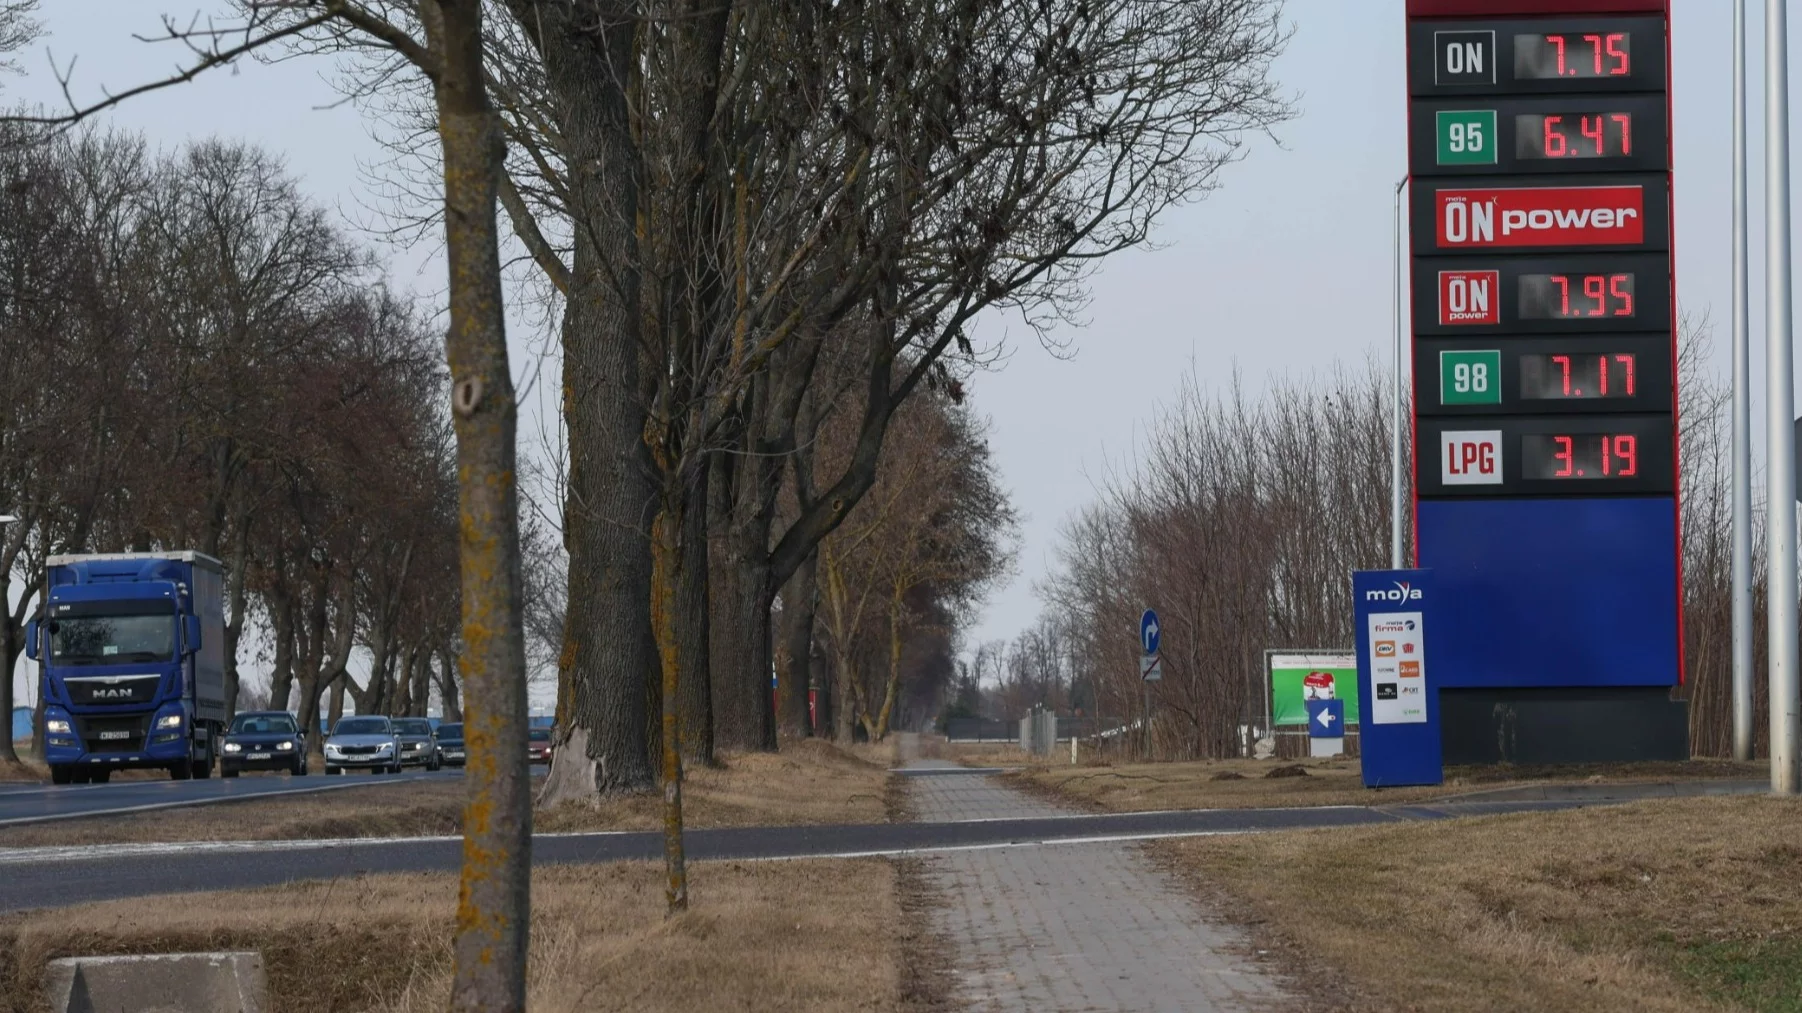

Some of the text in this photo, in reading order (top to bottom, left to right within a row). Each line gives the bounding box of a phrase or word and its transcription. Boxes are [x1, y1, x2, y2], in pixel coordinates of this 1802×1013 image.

[1446, 42, 1483, 74] ON
[1546, 34, 1628, 76] 7.75
[1449, 122, 1483, 153] 95
[1544, 114, 1629, 157] 6.47
[1445, 201, 1638, 243] ON power
[1449, 279, 1488, 312] ON
[1550, 275, 1632, 316] 7.95
[1449, 311, 1488, 321] power
[1454, 362, 1488, 393] 98
[1552, 355, 1633, 396] 7.17
[1448, 442, 1494, 475] LPG
[1554, 435, 1636, 477] 3.19
[92, 688, 133, 698] MAN
